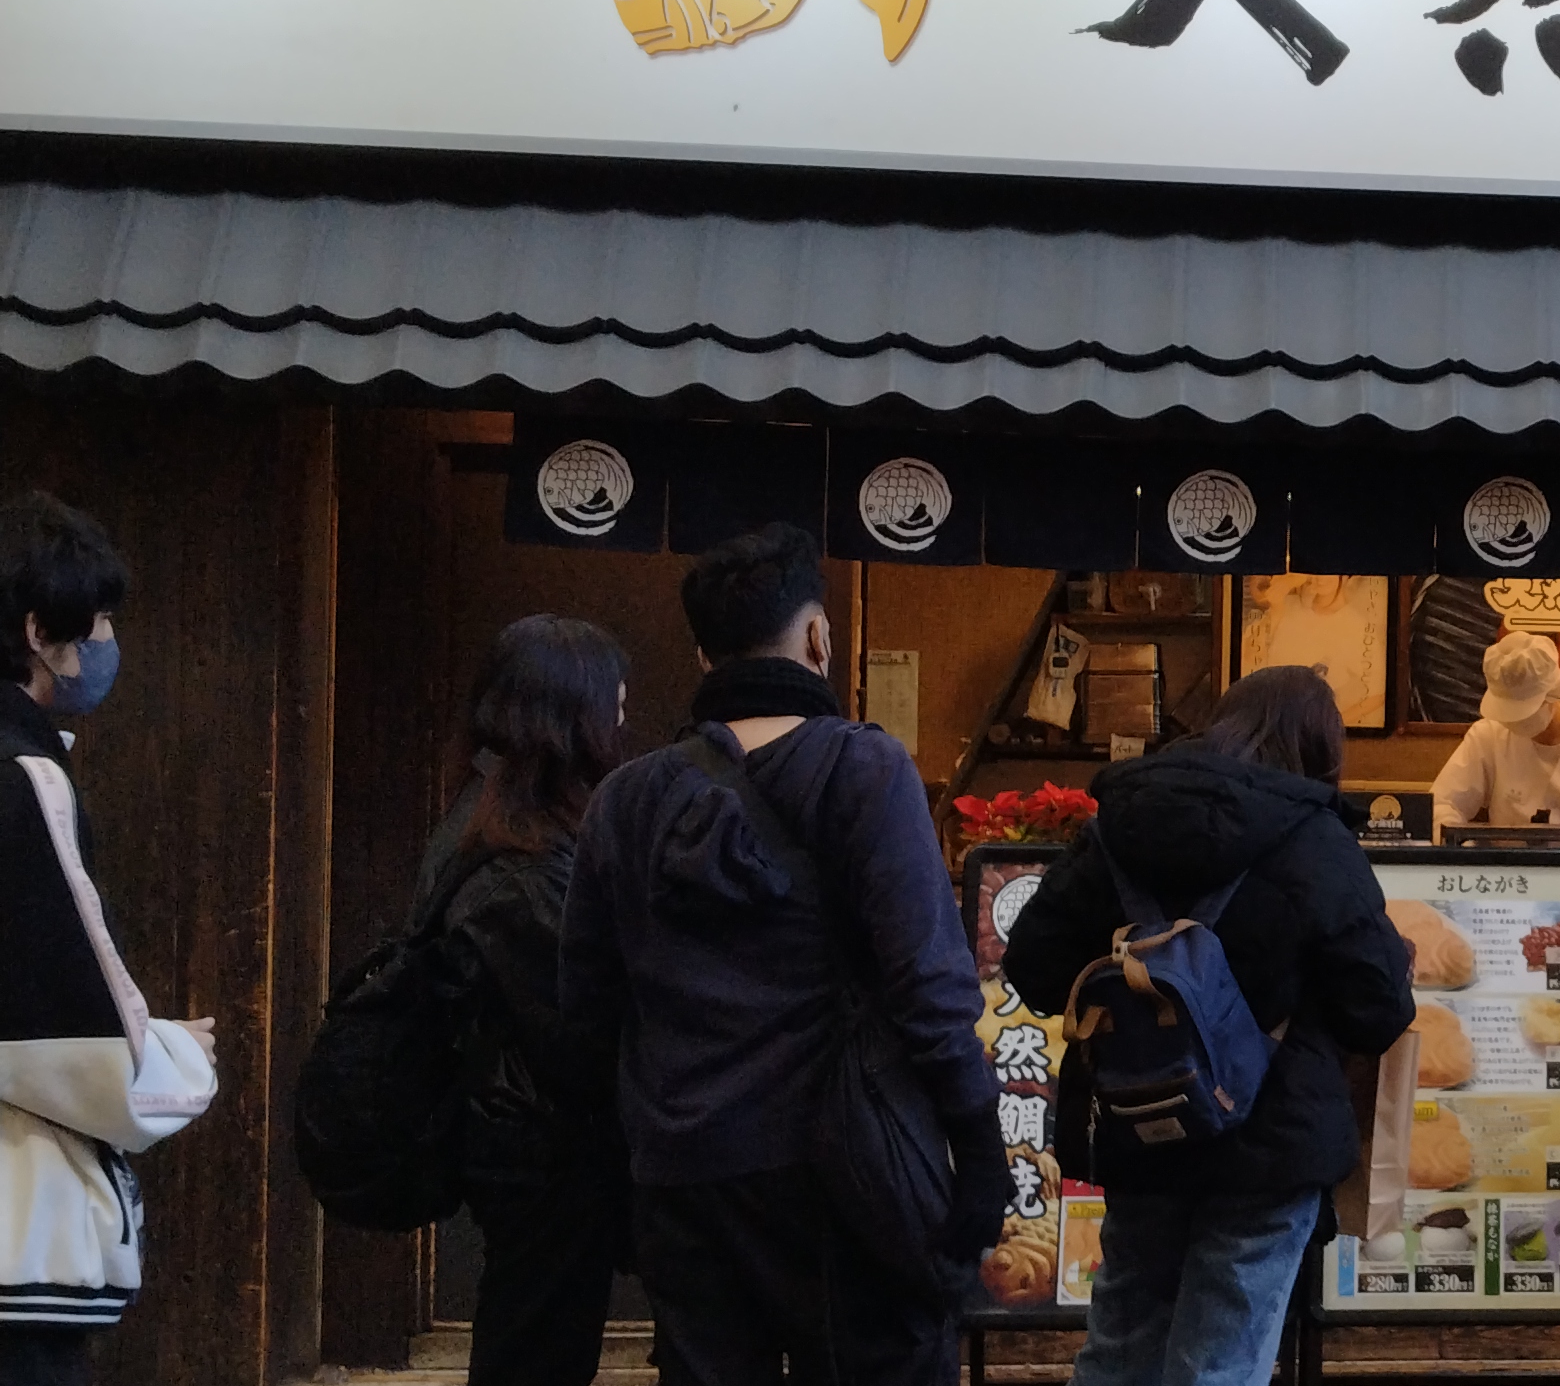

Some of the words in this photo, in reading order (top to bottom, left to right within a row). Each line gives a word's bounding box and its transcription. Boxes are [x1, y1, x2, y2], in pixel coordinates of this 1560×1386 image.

[1436, 874, 1530, 894] おしながき
